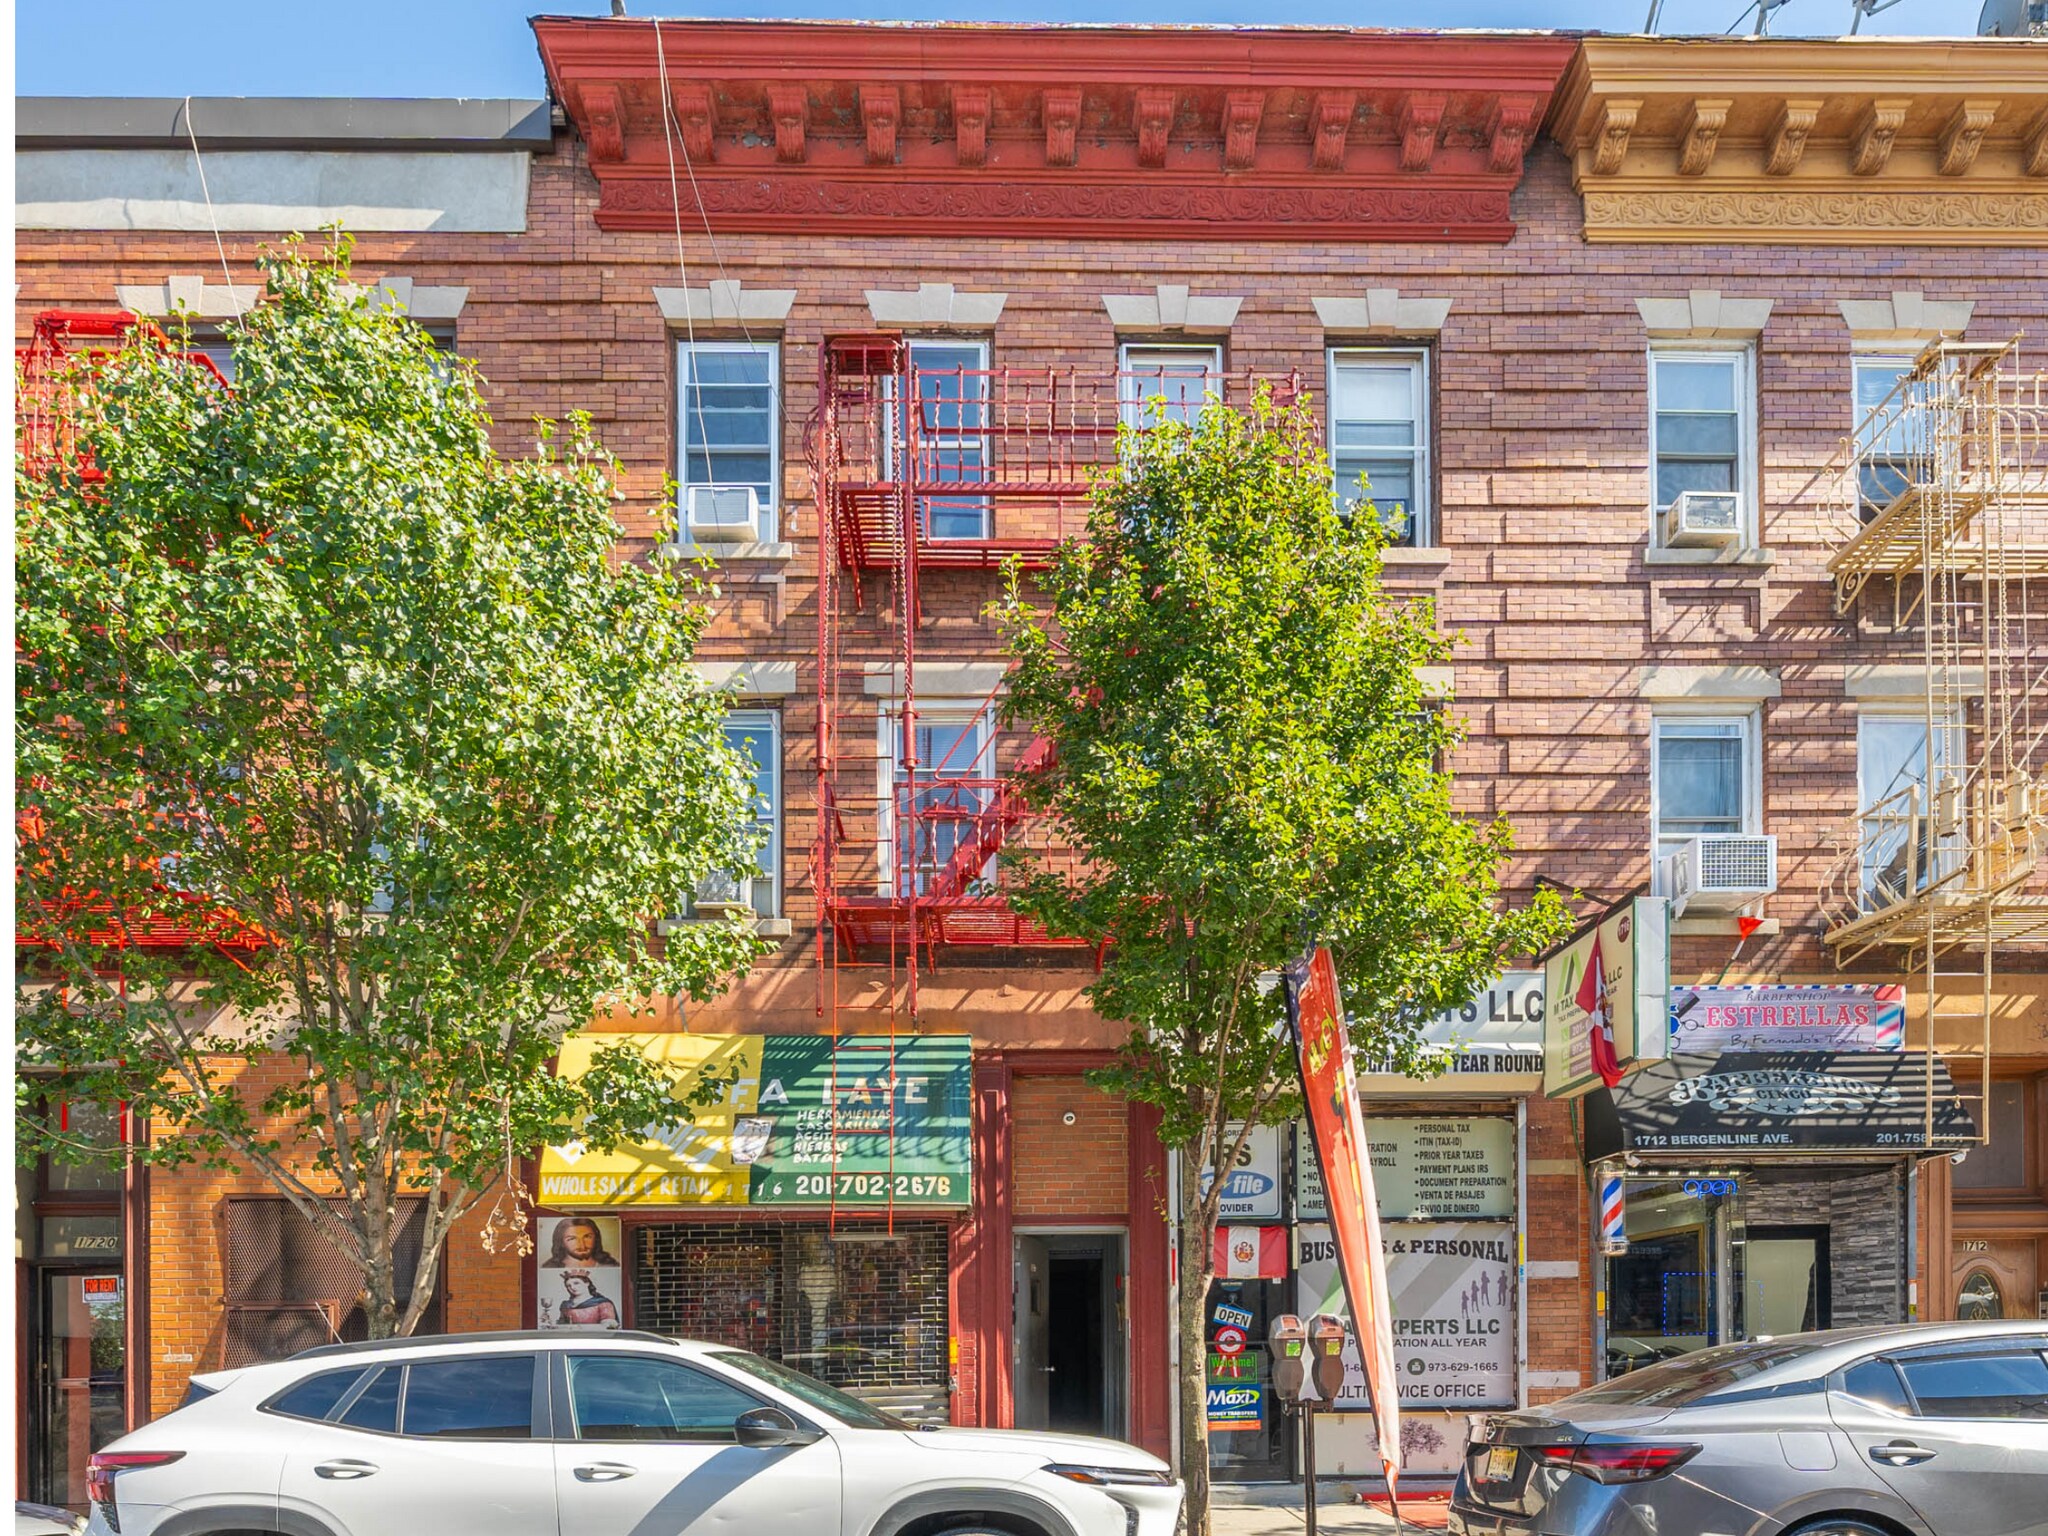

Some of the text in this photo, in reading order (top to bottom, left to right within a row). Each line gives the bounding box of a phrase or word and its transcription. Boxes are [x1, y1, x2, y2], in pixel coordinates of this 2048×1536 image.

[1608, 966, 1623, 984] LLC
[1489, 990, 1543, 1022] LLC
[1561, 996, 1574, 1012] TAX
[1705, 1003, 1871, 1028] ESTRELLAS
[1731, 1034, 1747, 1047] By
[1753, 1034, 1819, 1045] Fernando's
[1452, 1055, 1489, 1072] YEAR
[1494, 1055, 1543, 1072] ROUND
[822, 1077, 929, 1105] LAYE
[1756, 1090, 1812, 1099] CINCO
[797, 1108, 891, 1120] HERRAMIENTAS
[1420, 1124, 1470, 1133] PERSONAL TAX
[795, 1131, 836, 1141] ACEIT
[1420, 1136, 1462, 1148] ITIN (TAX-ID)
[1635, 1133, 1793, 1145] 1712 BERGENLINE AVE.
[1420, 1151, 1484, 1160] PRIOR YEAR TAXES
[1370, 1157, 1397, 1167] AYROLL
[1420, 1164, 1488, 1173] PAYMENT PLANS IRS
[542, 1175, 636, 1196] WHOLESALE
[660, 1174, 713, 1196] RETAIL
[1420, 1177, 1507, 1187] DOCUMENT PREPARATION
[1420, 1190, 1485, 1200] VENTA DE PASAJES
[1683, 1179, 1737, 1199] open
[1219, 1203, 1254, 1213] OVIDER
[1421, 1203, 1479, 1213] ENVIO DE DINERO
[77, 1236, 117, 1248] 1720
[1964, 1242, 1987, 1251] 1712
[1392, 1240, 1406, 1254] &
[1410, 1239, 1509, 1264] PERSONAL
[85, 1279, 116, 1292] FOR RENT
[1218, 1308, 1250, 1331] OPEN
[1466, 1319, 1500, 1335] LLC
[1431, 1338, 1452, 1347] ALL
[1457, 1338, 1487, 1347] YEAR
[1428, 1362, 1498, 1372] 973-629-1665
[1207, 1388, 1250, 1405] Maxi
[1434, 1384, 1486, 1397] OFFICE
